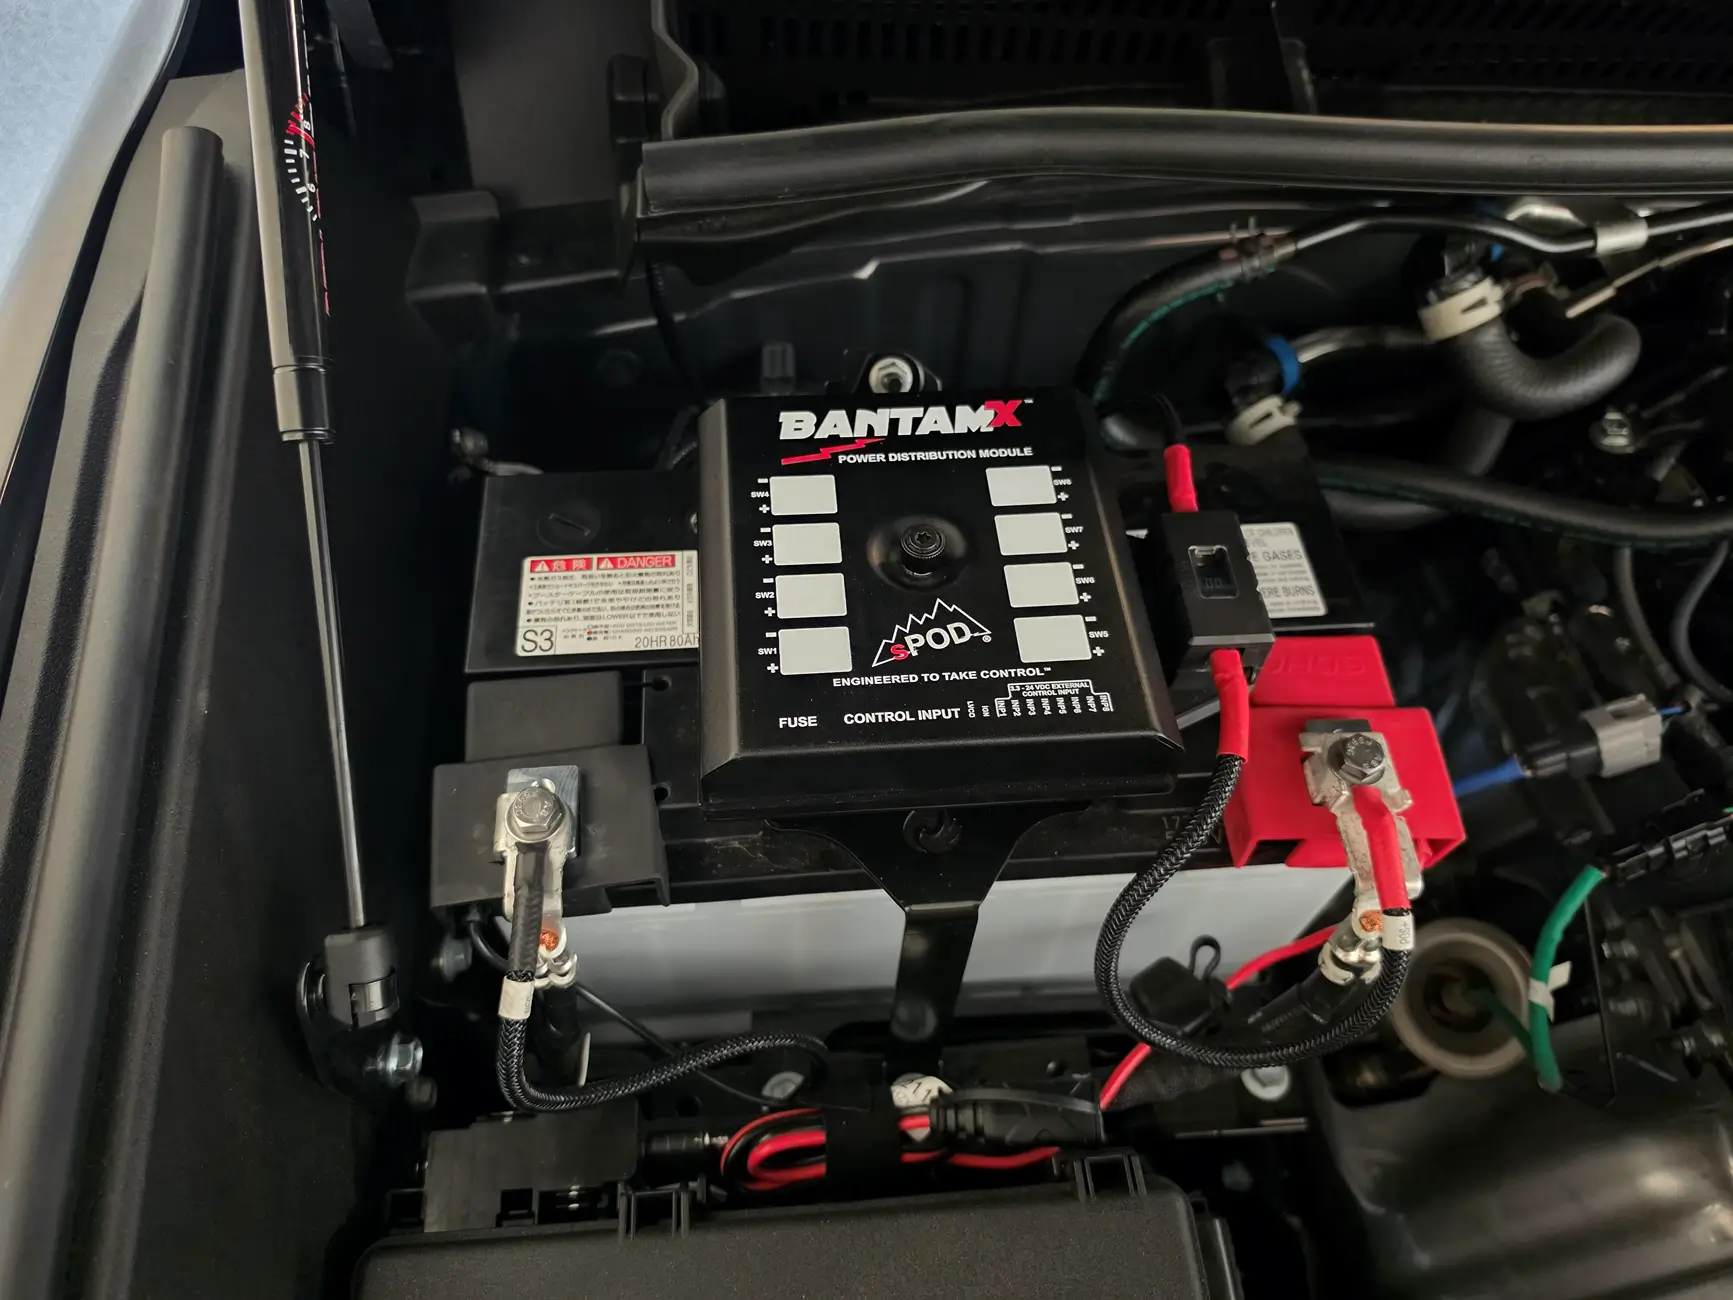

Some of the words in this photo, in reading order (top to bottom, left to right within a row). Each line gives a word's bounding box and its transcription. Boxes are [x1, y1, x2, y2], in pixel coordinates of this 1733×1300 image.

[299, 148, 310, 160] 7
[838, 453, 886, 464] POWER
[888, 450, 977, 463] DISTRIBUTION
[979, 447, 1034, 459] MODULE
[1053, 478, 1072, 486] SW8
[750, 491, 770, 499] SW4
[1064, 526, 1084, 534] SW7
[753, 539, 773, 547] SW3
[617, 555, 674, 570] DANGER
[1075, 576, 1096, 584] SW6
[755, 591, 775, 599] SW2
[1281, 585, 1317, 597] BURNS
[1088, 630, 1109, 638] SW5
[520, 629, 555, 654] S3
[634, 636, 668, 649] 20HR
[757, 647, 777, 655] SW1
[832, 673, 919, 687] ENGINEERED
[921, 672, 940, 683] TO
[941, 670, 978, 681] TAKE
[1021, 690, 1058, 698] CONTROL
[1058, 688, 1080, 696] INPUT
[1035, 683, 1051, 691] VDC
[1051, 682, 1090, 690] EXTERNAL
[966, 700, 976, 718] LVCO
[997, 700, 1008, 717] INP1
[1011, 699, 1022, 717] INP2
[1026, 698, 1037, 716] INP3
[1041, 697, 1052, 715] INP4
[1056, 697, 1067, 715] INP5
[1071, 696, 1082, 714] INP6
[1086, 695, 1097, 713] INP7
[1100, 695, 1111, 712] INP8
[843, 710, 916, 725] CONTROL
[917, 707, 961, 721] INPUT
[981, 705, 990, 717] IGN
[778, 715, 818, 729] FUSE
